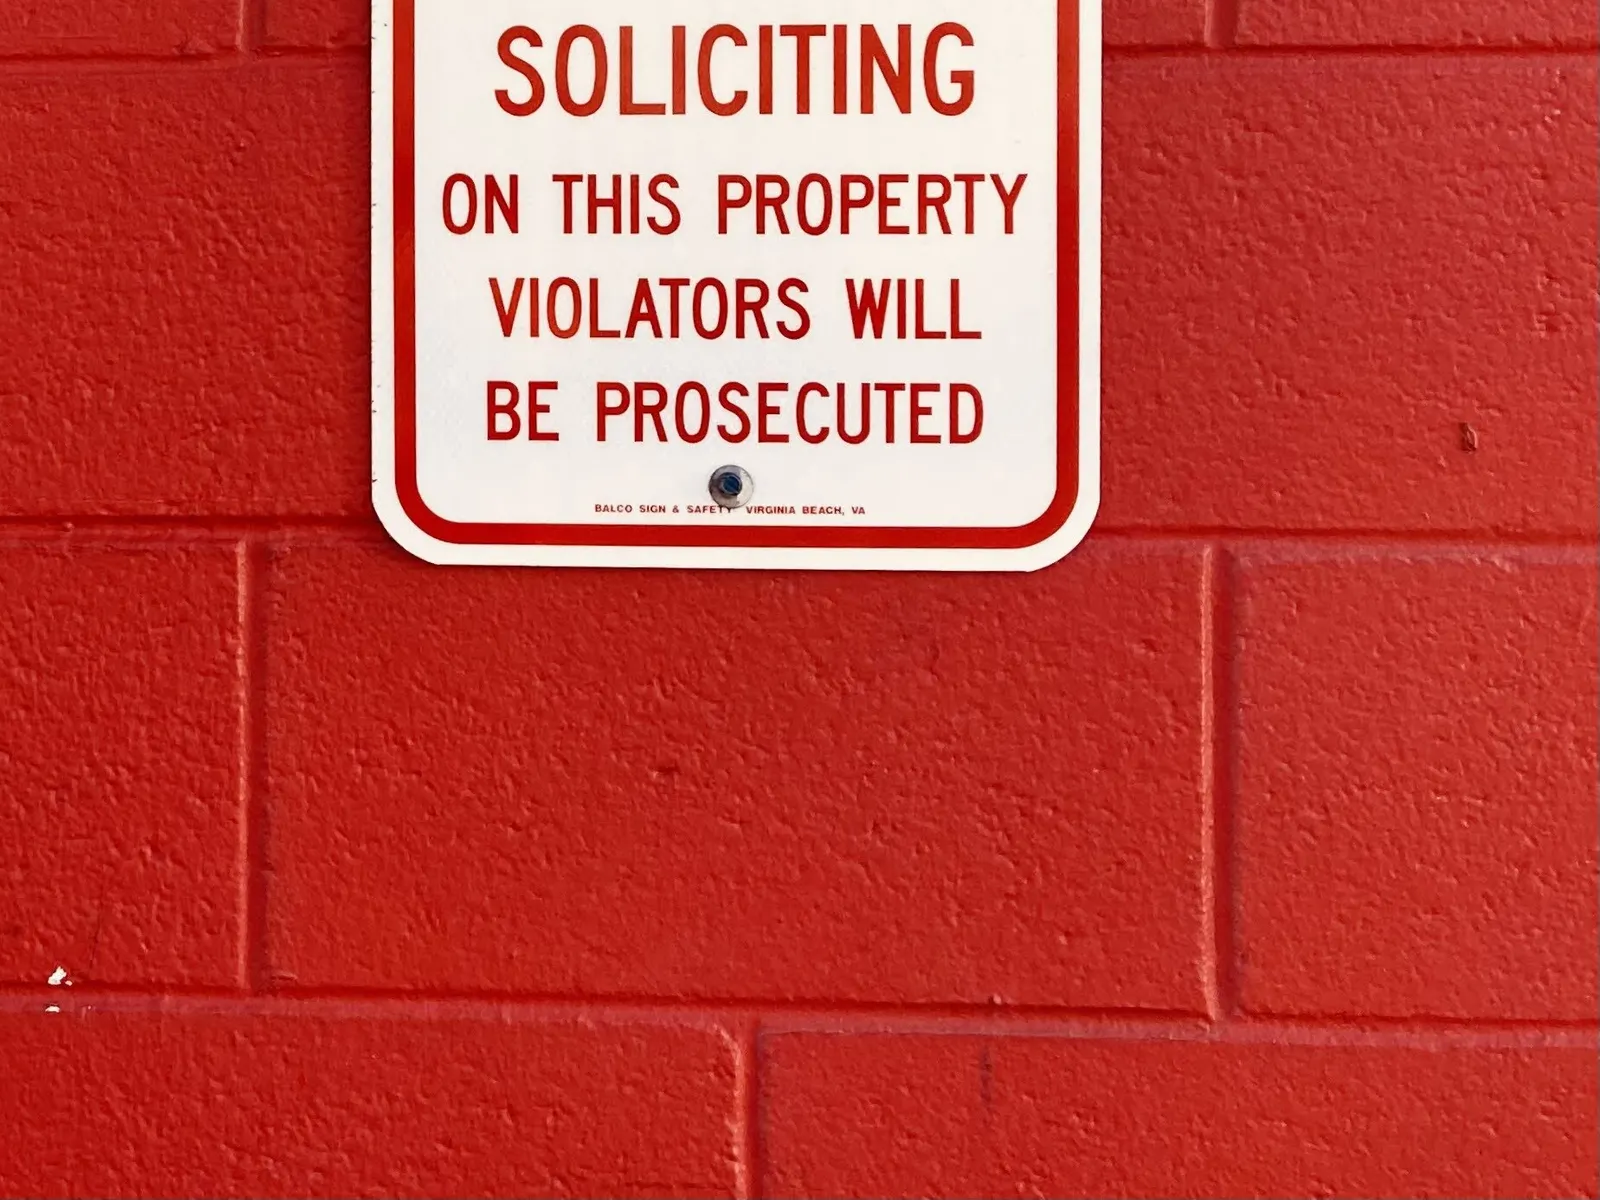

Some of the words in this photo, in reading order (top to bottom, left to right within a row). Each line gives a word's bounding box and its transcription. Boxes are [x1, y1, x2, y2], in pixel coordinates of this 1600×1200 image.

[495, 22, 974, 117] SOLICITING
[442, 173, 518, 235] ON
[552, 174, 681, 235] THIS
[718, 173, 1027, 236] PROPERTY
[489, 277, 810, 340] VIOLATORS
[845, 279, 981, 339] WILL
[487, 381, 559, 441] BE
[597, 381, 983, 444] PROSECUTED
[594, 503, 633, 514] BALCO
[639, 504, 666, 514] SIGN
[672, 505, 680, 514] &
[744, 504, 796, 515] VIRGINIA
[802, 505, 845, 516] BEACH,
[851, 506, 866, 515] VA
